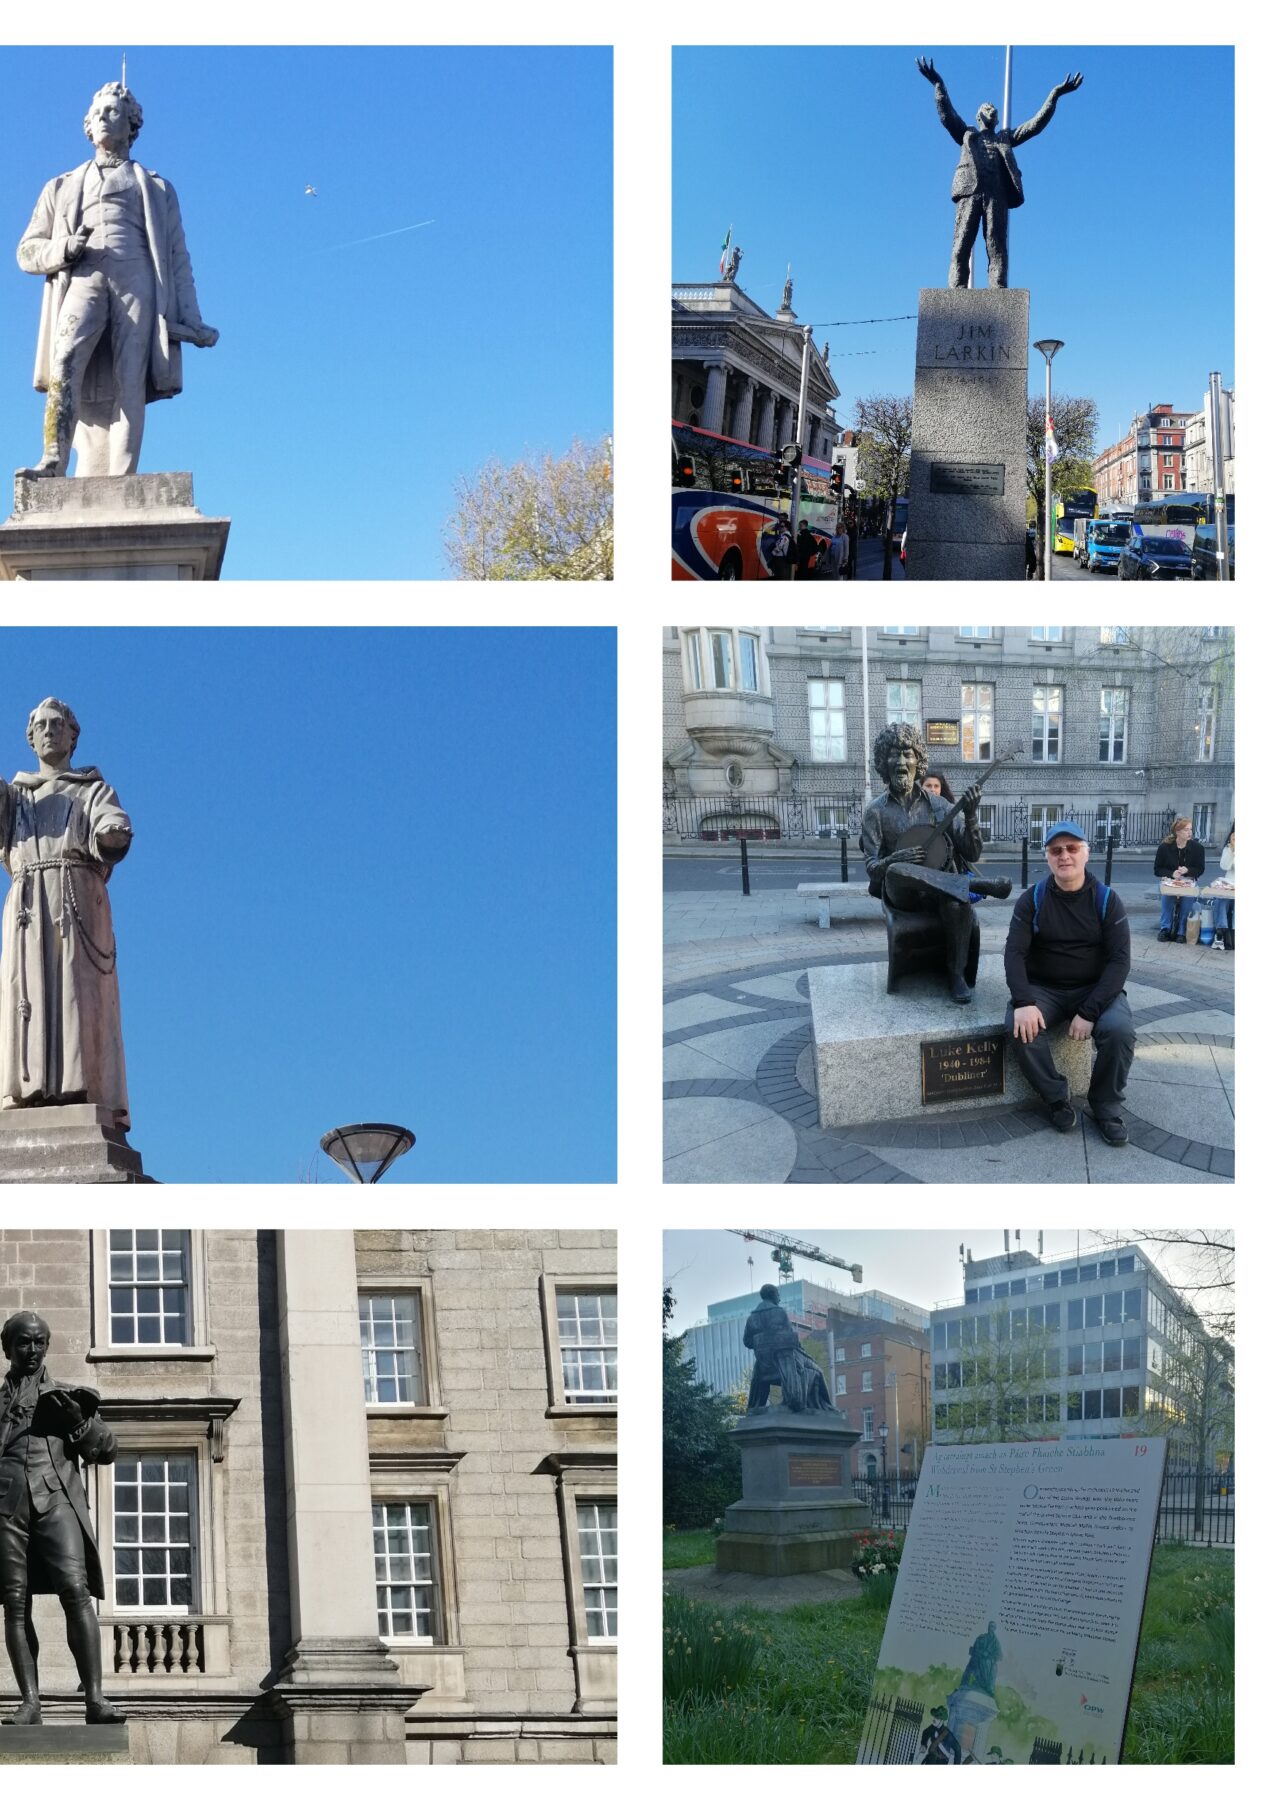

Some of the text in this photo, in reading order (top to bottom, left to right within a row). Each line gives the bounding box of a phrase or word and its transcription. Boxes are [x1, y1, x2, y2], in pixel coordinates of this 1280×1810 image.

[957, 324, 993, 340] JIM
[934, 344, 1012, 361] LARKIN
[930, 1041, 999, 1059] Luke Kelly
[1134, 1444, 1148, 1457] 19
